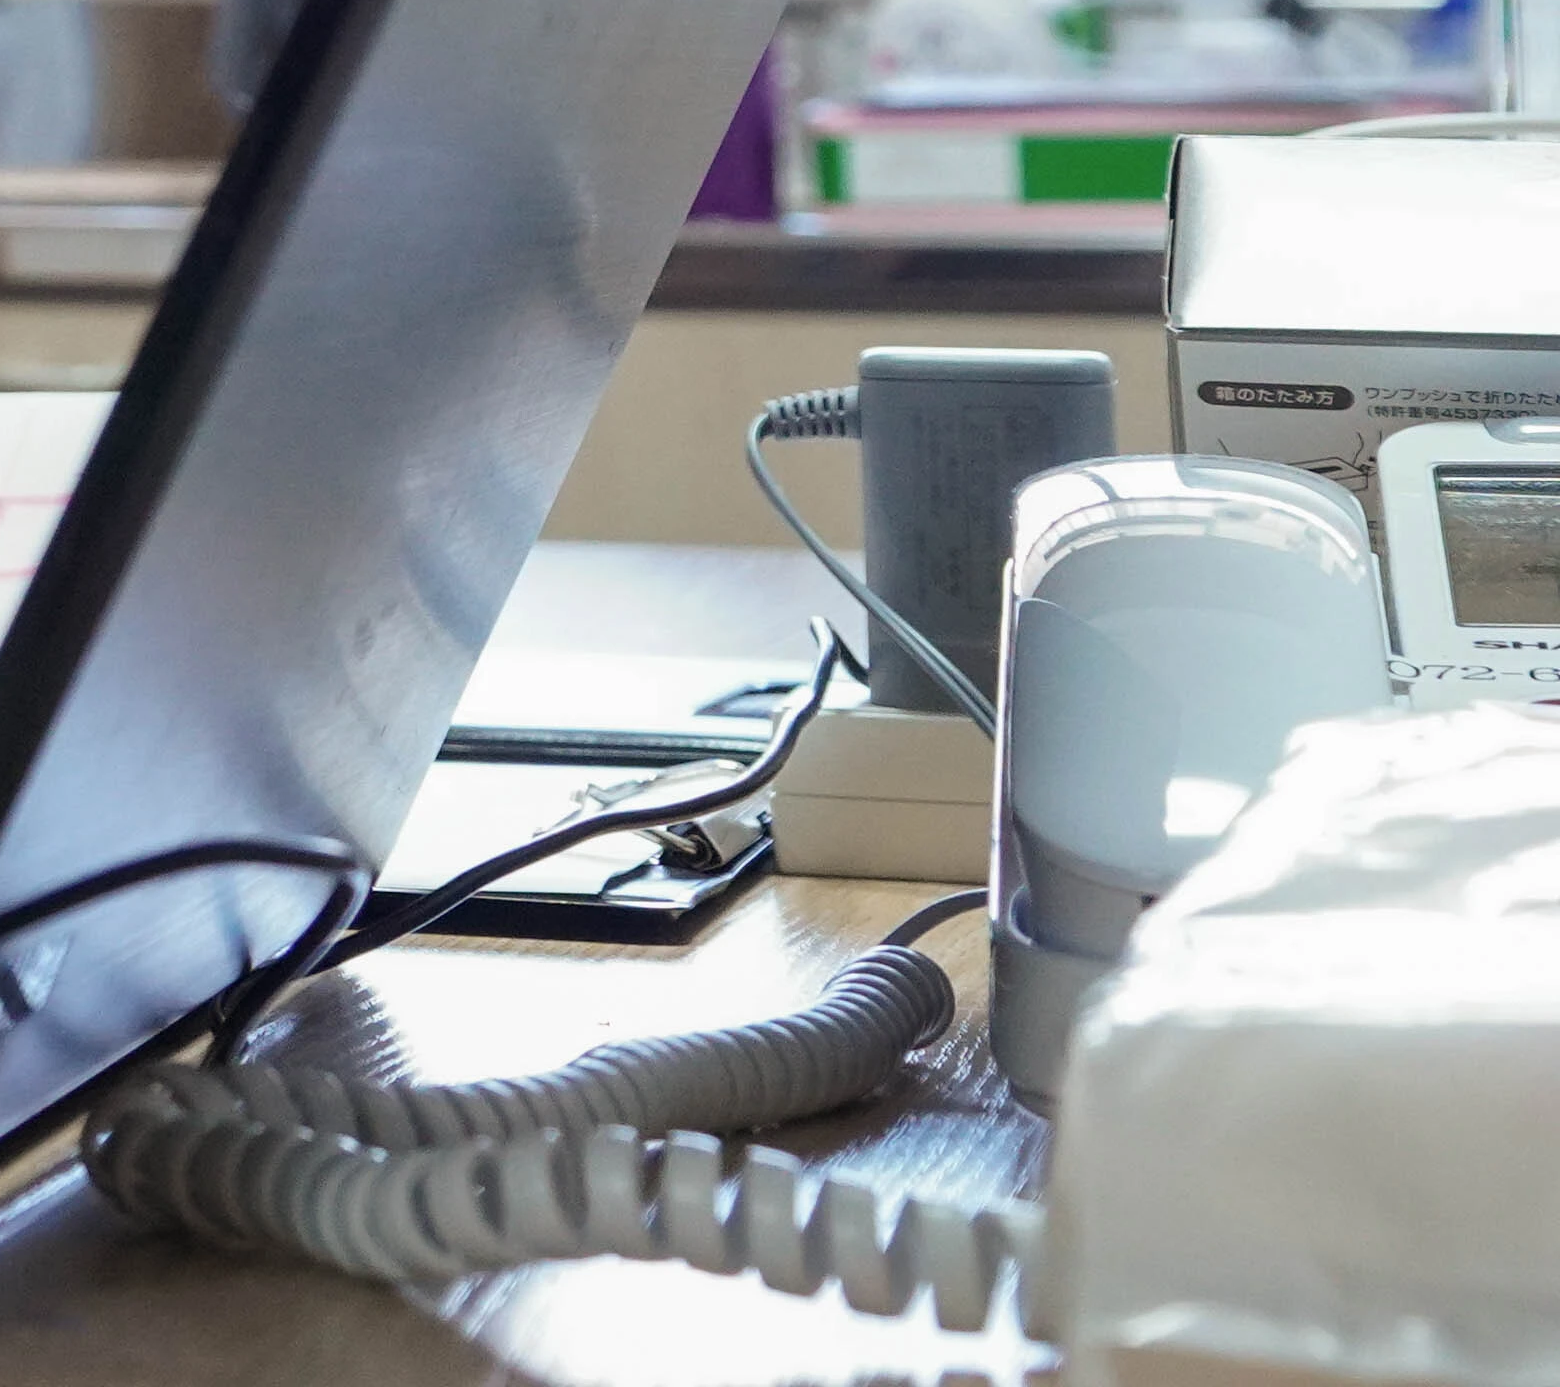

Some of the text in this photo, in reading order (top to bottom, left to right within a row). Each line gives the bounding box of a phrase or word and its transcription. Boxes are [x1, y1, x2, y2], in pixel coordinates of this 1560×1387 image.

[1214, 385, 1336, 406] 箱のたたみ方
[1473, 639, 1560, 650] SH
[1386, 659, 1560, 683] 072-6
